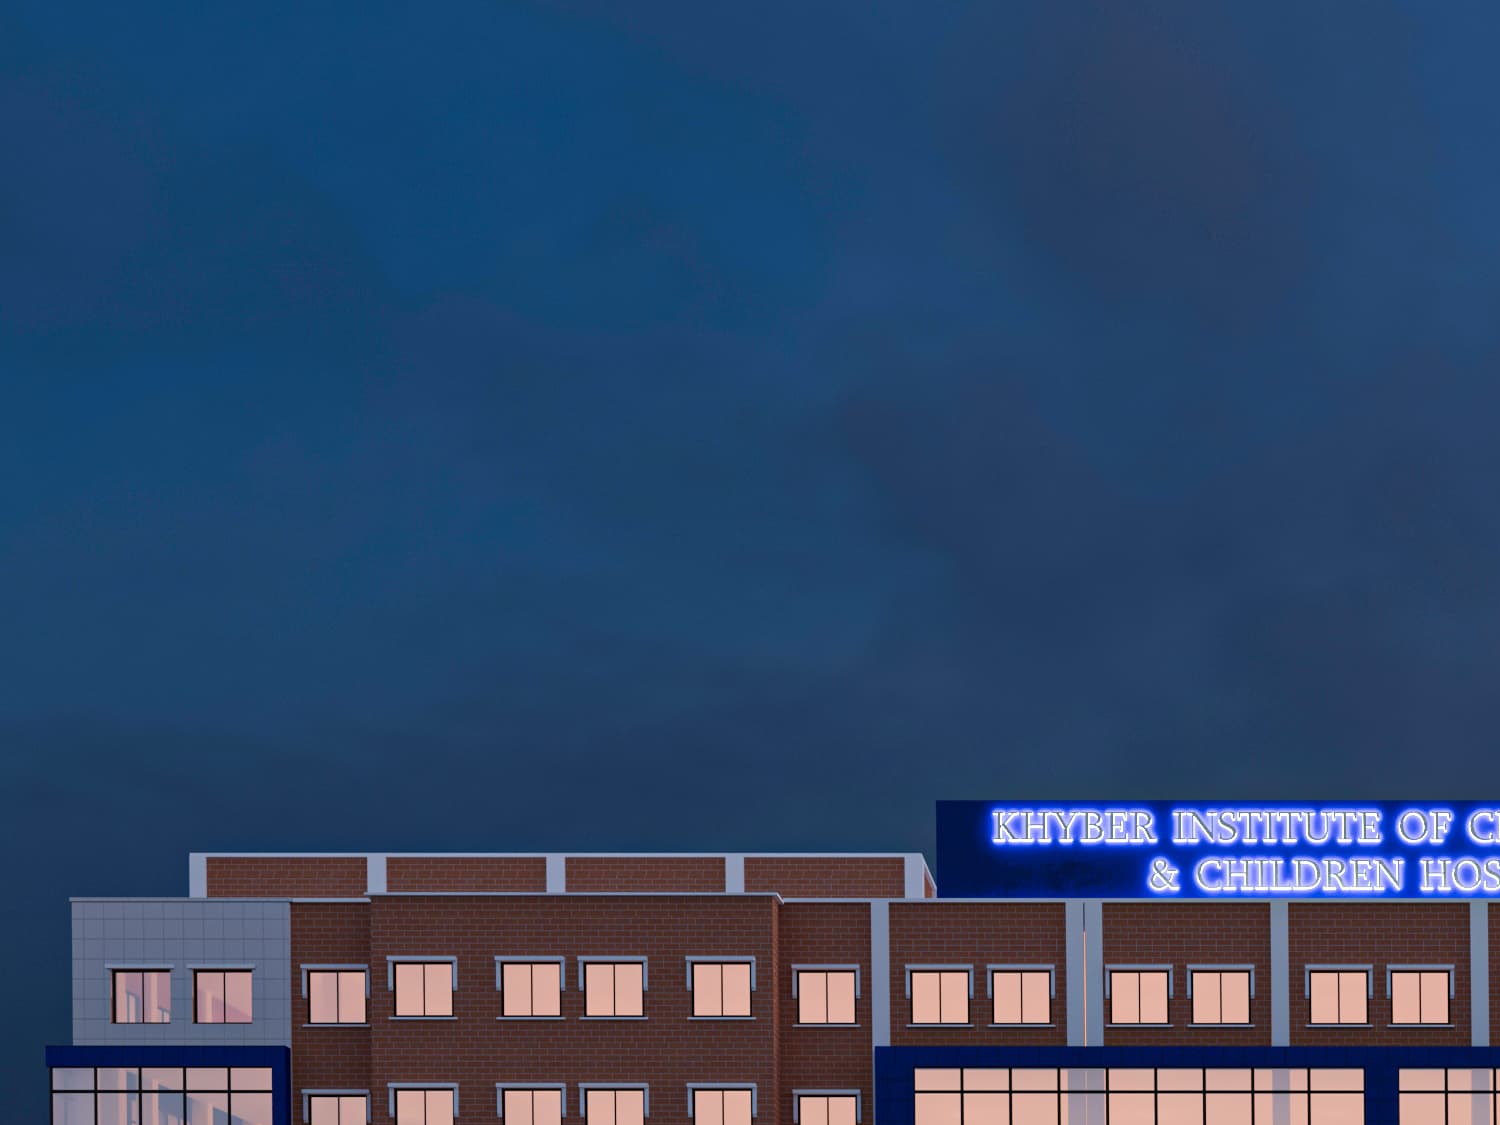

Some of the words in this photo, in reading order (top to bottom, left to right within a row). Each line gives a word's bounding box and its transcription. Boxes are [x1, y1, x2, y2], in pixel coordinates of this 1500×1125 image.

[992, 809, 1158, 844] KHYBER
[1172, 809, 1382, 844] INSTITUTE
[1397, 810, 1453, 844] OF
[1148, 857, 1180, 892] &
[1195, 857, 1405, 892] CHILDREN
